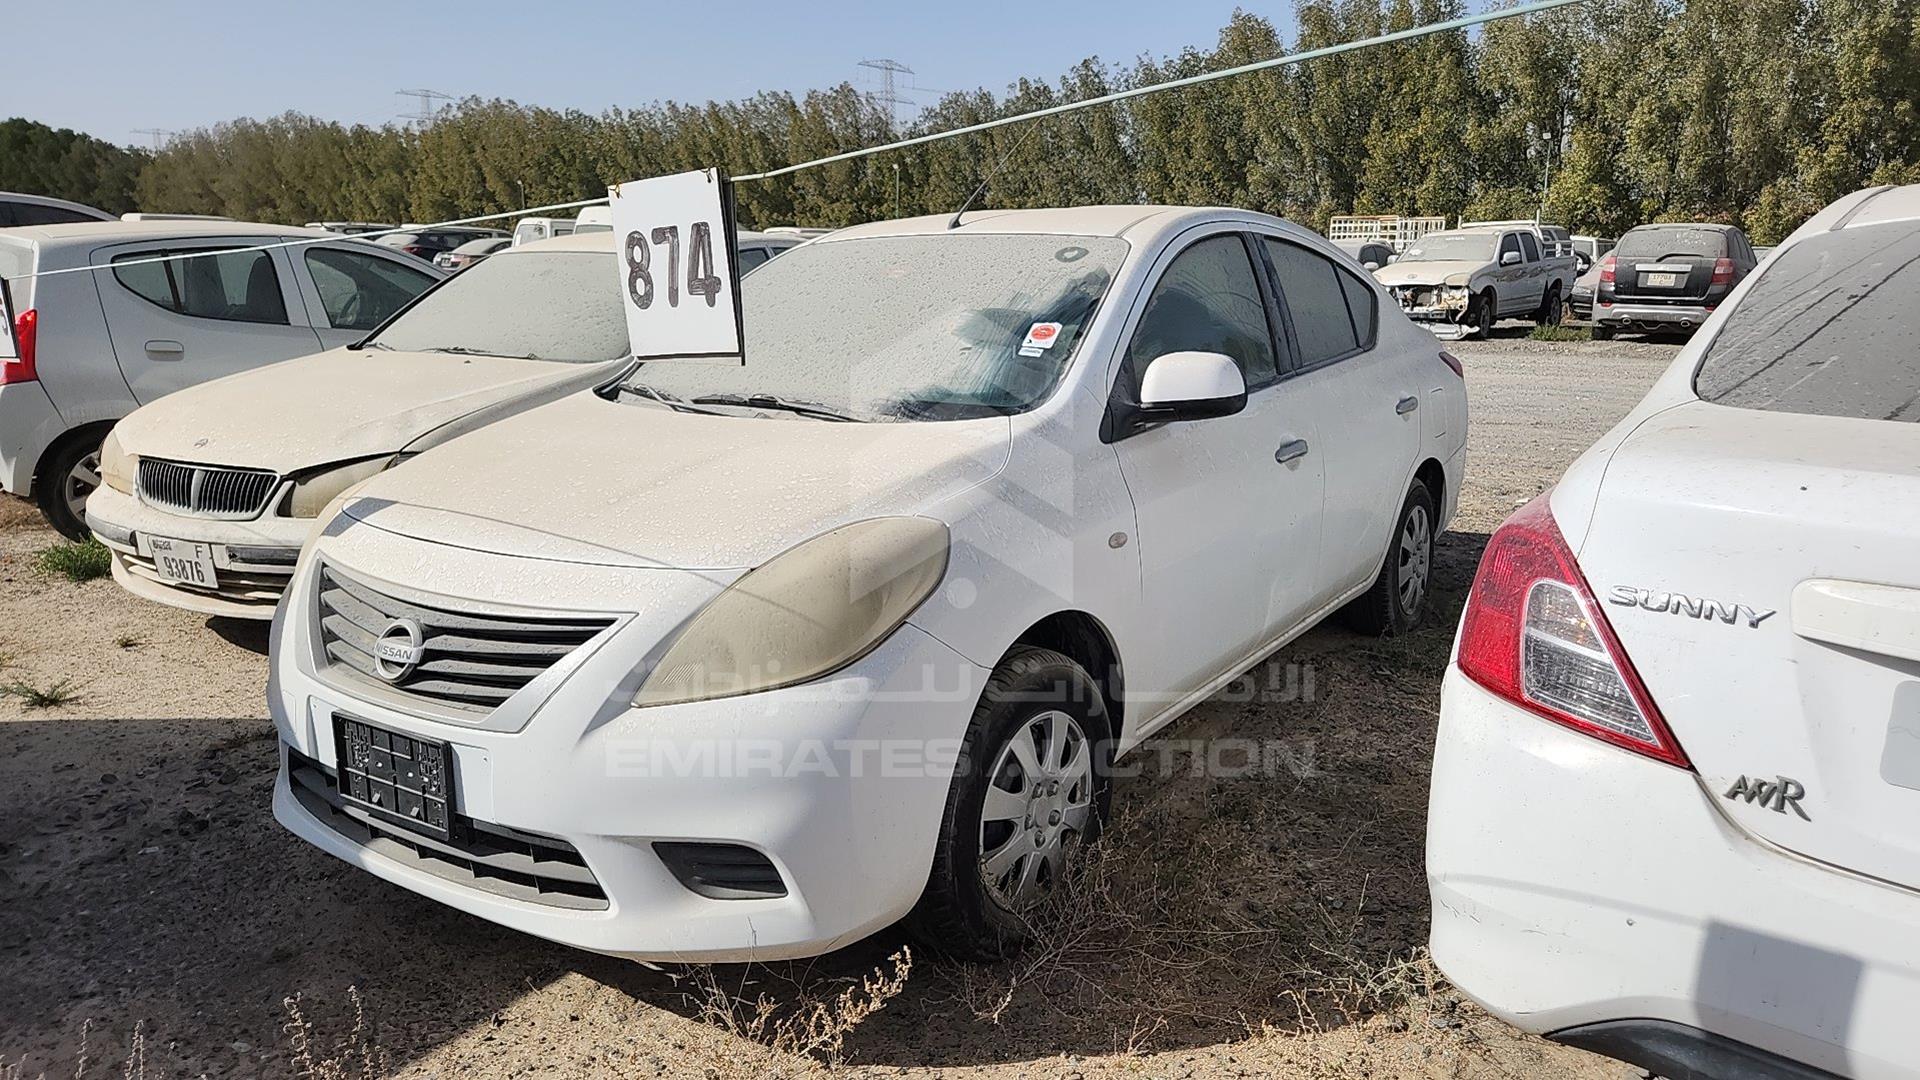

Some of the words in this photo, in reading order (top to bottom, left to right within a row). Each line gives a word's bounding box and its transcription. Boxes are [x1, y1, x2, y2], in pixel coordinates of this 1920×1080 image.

[625, 221, 722, 310] 874
[163, 556, 205, 583] 93876
[194, 544, 203, 559] F
[1608, 584, 1777, 629] SUNNY
[376, 643, 413, 660] NISSAN
[1722, 774, 1812, 822] AWR
